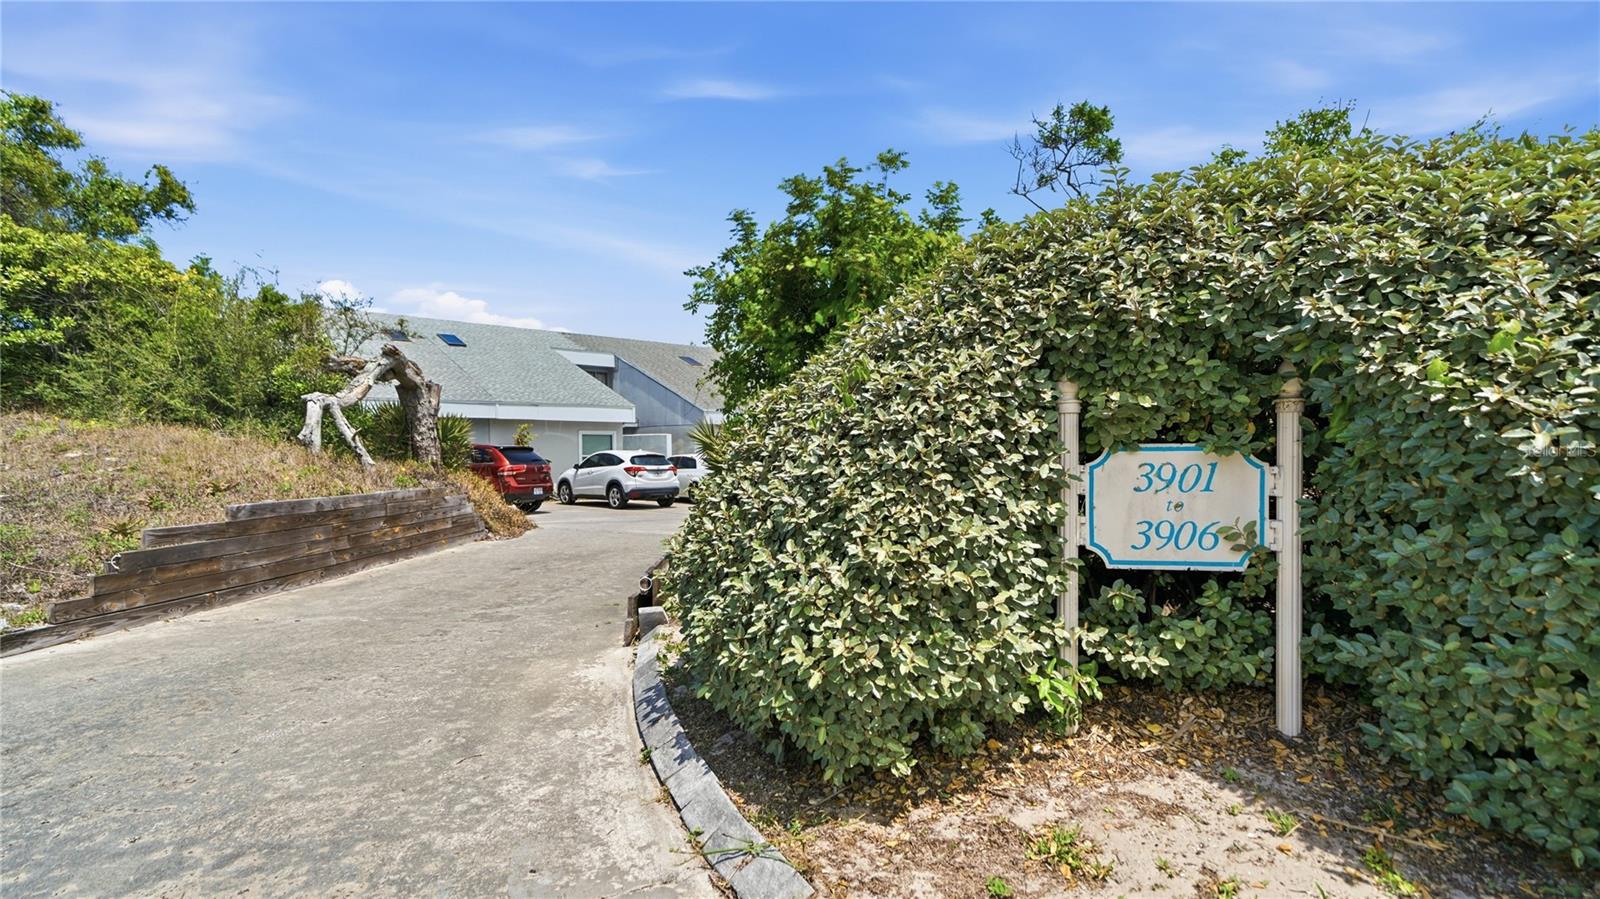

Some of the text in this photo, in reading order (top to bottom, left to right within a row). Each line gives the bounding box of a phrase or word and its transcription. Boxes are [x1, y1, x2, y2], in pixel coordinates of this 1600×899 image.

[1133, 462, 1219, 494] 3901
[1166, 500, 1184, 512] to
[1131, 520, 1220, 551] 3906
